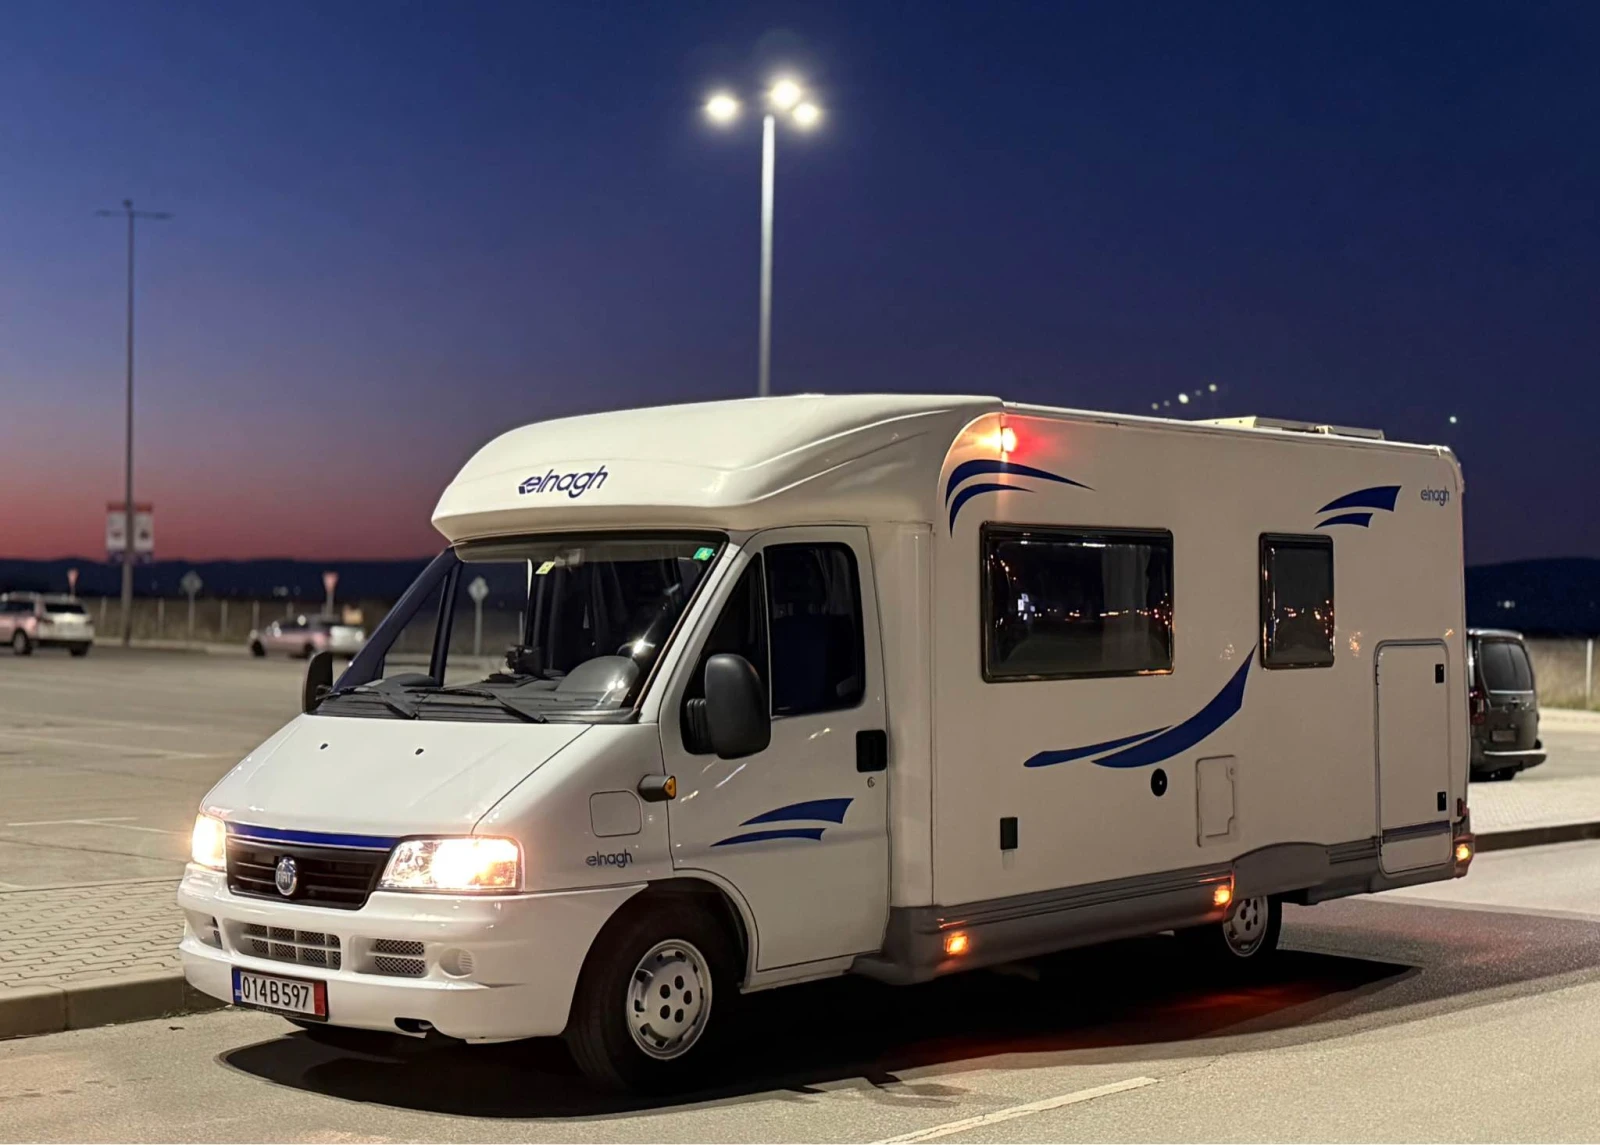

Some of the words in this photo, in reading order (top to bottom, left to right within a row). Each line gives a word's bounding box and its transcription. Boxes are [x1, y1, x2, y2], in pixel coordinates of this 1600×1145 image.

[518, 465, 608, 498] elnagh
[1420, 485, 1450, 507] elnagh
[585, 848, 633, 869] elnagh
[242, 976, 309, 1009] 014B597
